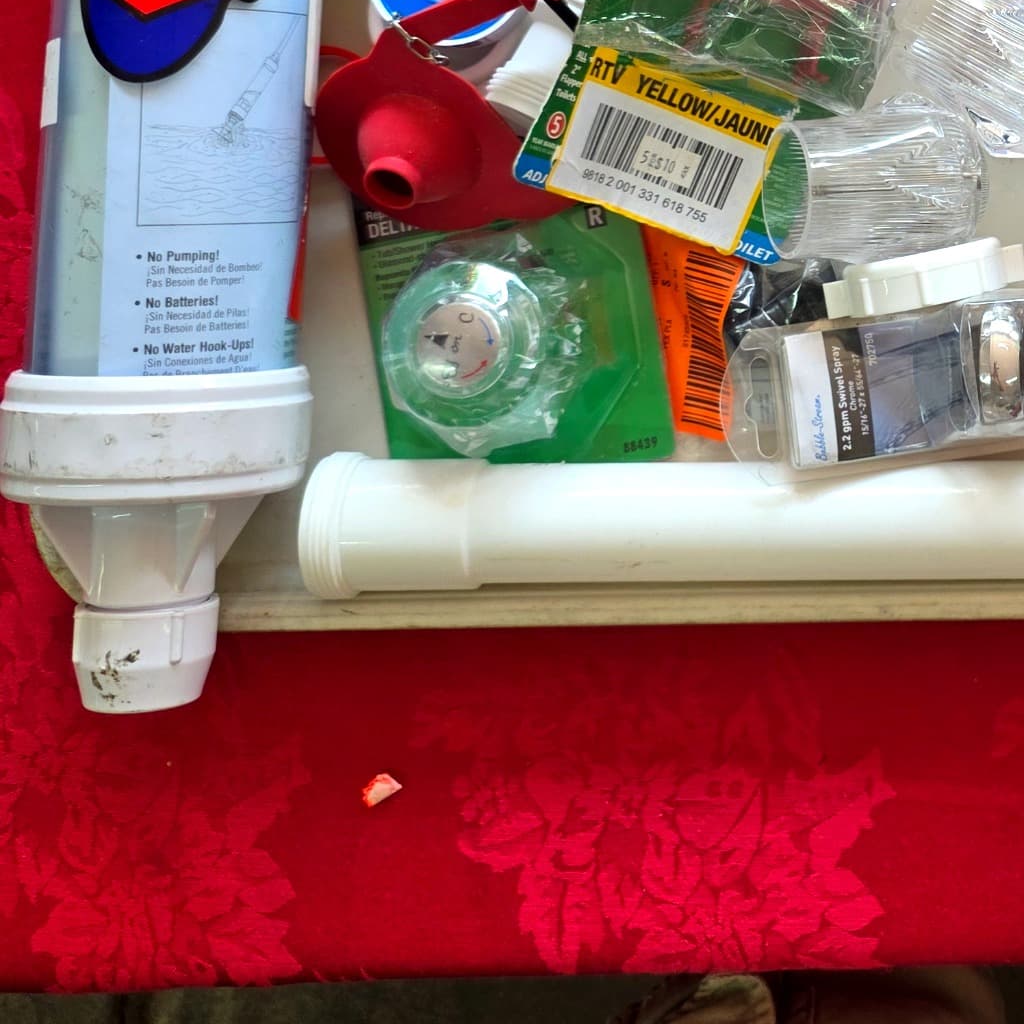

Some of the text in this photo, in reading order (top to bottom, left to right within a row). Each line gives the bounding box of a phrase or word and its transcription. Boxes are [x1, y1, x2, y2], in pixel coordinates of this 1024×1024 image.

[576, 50, 589, 63] ALL
[590, 57, 629, 85] RTV
[560, 74, 583, 88] Flapper
[556, 88, 576, 104] Toilets
[551, 114, 563, 135] 5
[582, 168, 708, 223] 9818 2 001 331 618 755
[147, 250, 219, 263] No Pumping!
[733, 239, 774, 261] OILET
[168, 264, 214, 275] Necesidad
[216, 264, 226, 273] de
[146, 279, 163, 288] Pas
[165, 277, 195, 287] Besoin
[198, 277, 209, 286] de
[145, 295, 219, 308] No Batteries!
[166, 309, 212, 320] Necesidad
[214, 309, 224, 318] de
[144, 325, 161, 334] Pas
[163, 323, 193, 334] Besoin
[196, 322, 207, 332] de
[143, 338, 254, 355] No Water Hook-Ups!
[863, 332, 878, 367] 702750
[164, 354, 213, 367] Conexiones
[216, 353, 226, 363] de
[832, 345, 852, 451] 2.2 gpm Swivel Spray
[848, 380, 860, 411] Chrome
